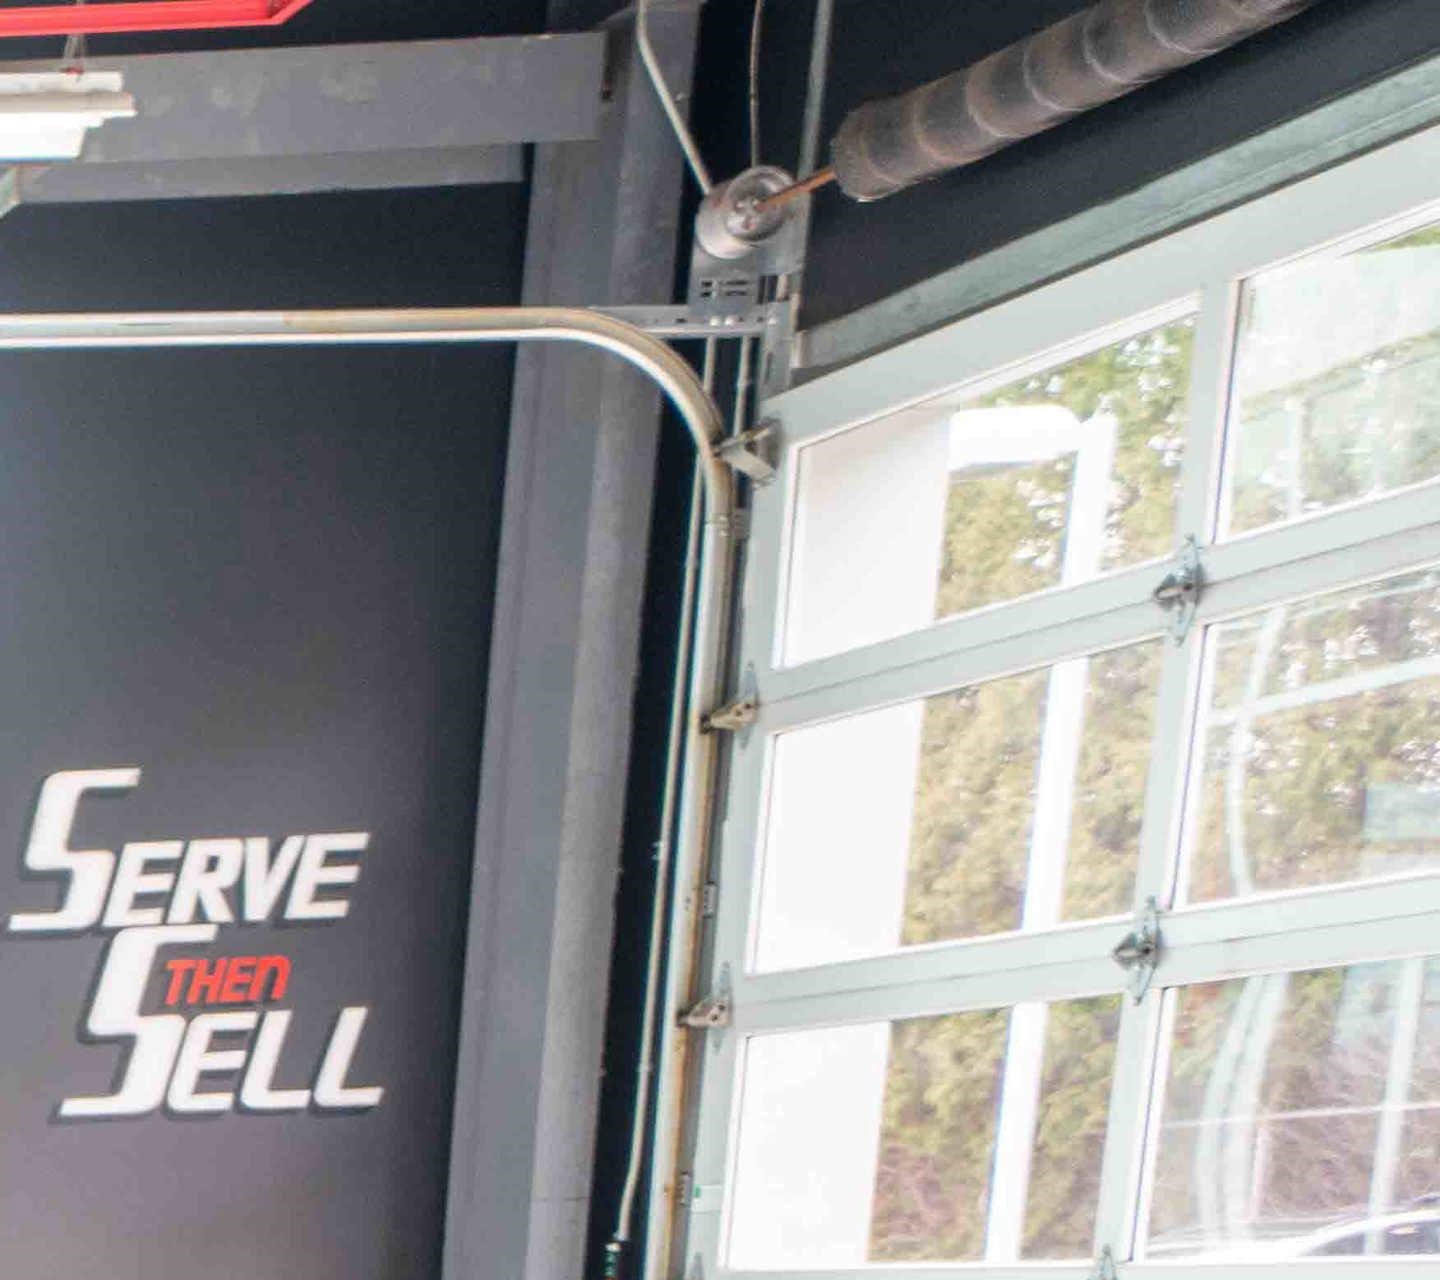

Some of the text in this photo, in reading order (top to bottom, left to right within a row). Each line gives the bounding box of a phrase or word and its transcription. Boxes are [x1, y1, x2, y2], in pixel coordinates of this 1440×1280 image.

[7, 767, 370, 933] SERVE
[59, 924, 386, 1118] SELL
[164, 954, 292, 1004] THEN
